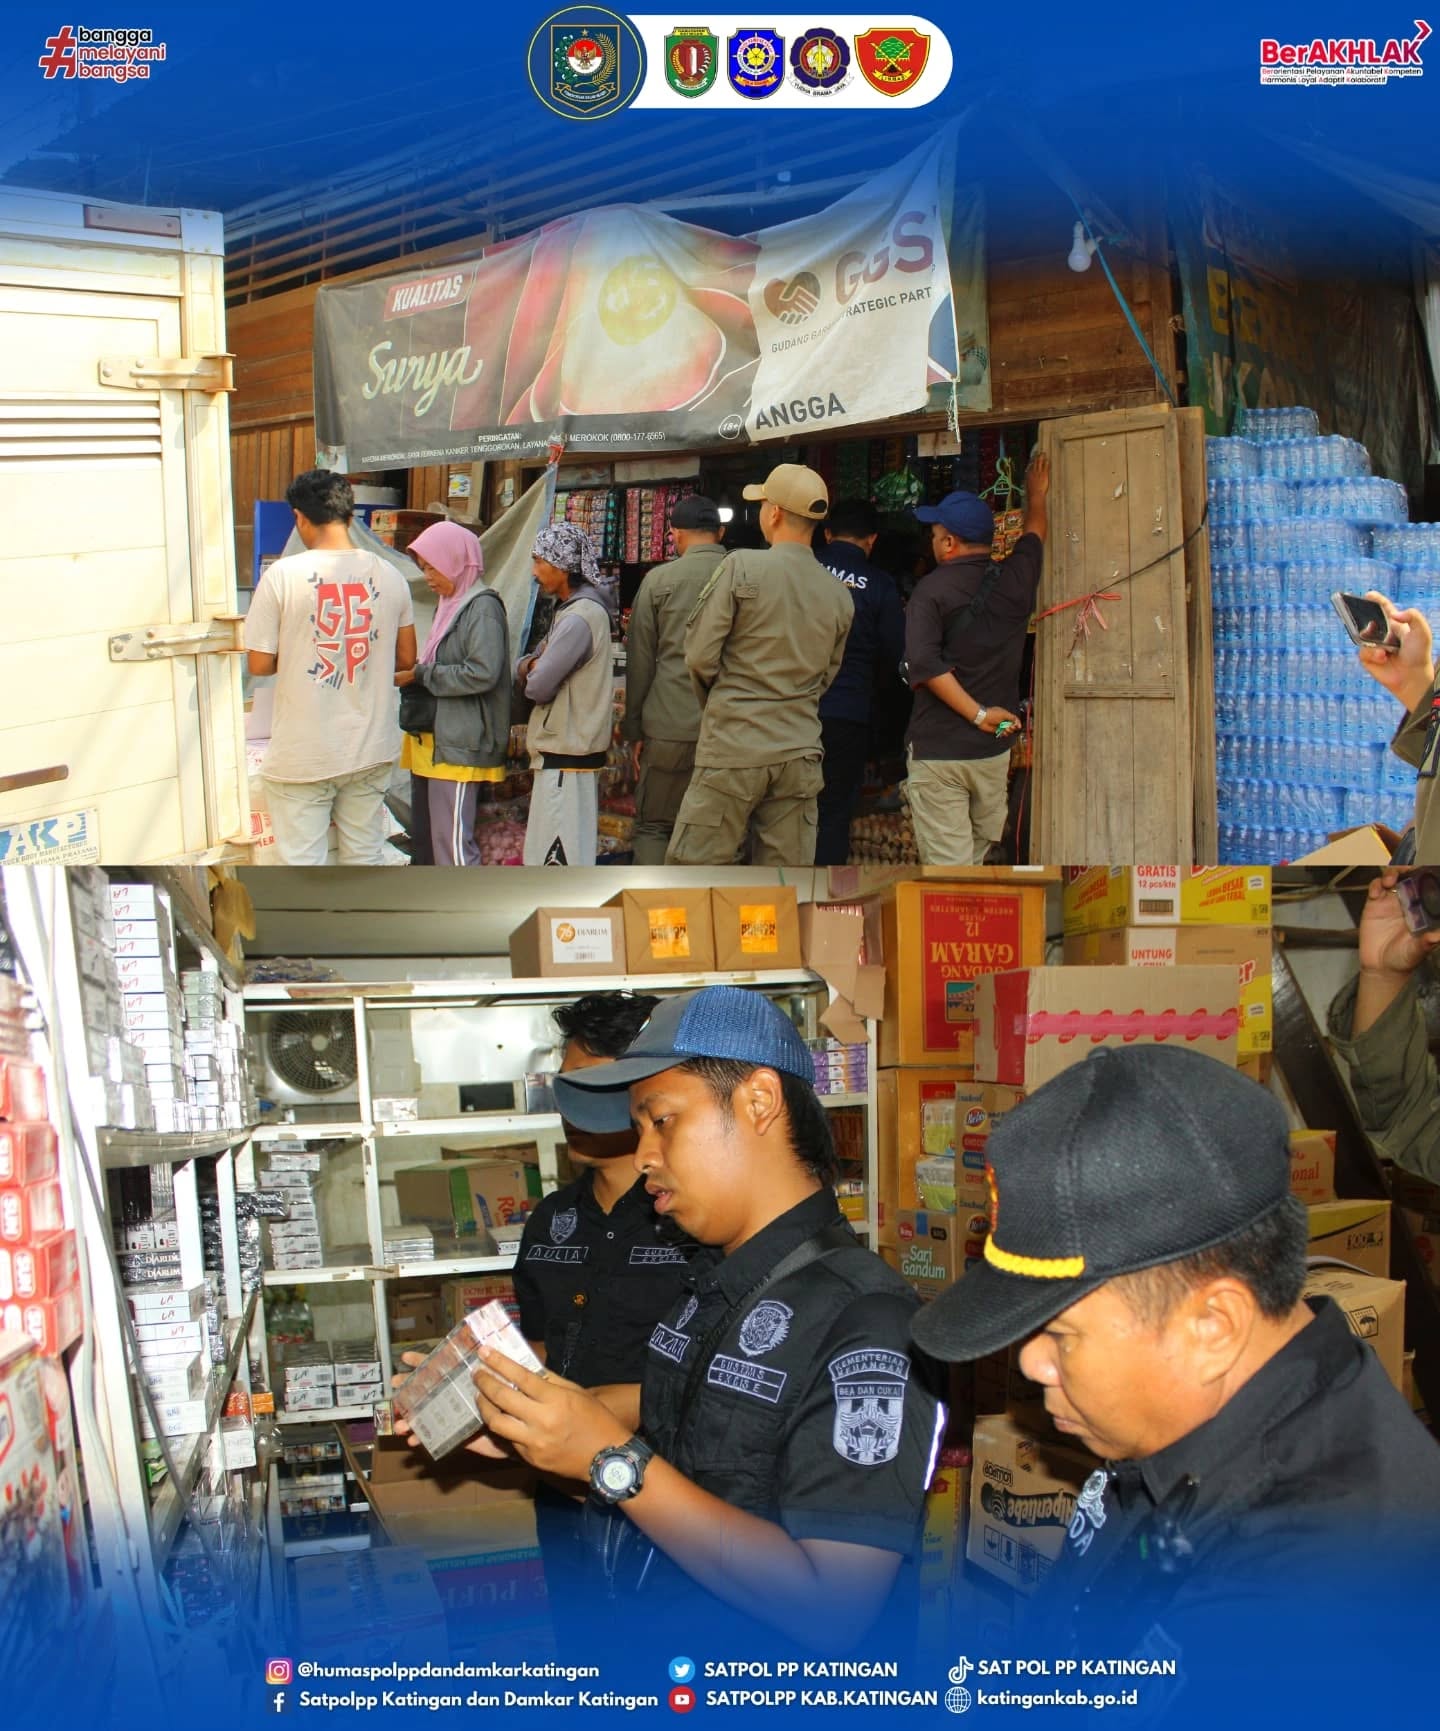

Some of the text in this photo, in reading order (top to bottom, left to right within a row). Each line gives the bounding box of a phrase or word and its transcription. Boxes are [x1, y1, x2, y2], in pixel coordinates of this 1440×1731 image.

[391, 273, 463, 313] KUALITAS
[771, 333, 809, 353] GUDANG
[362, 341, 484, 417] Surya
[755, 391, 847, 431] ANGGA
[569, 433, 609, 443] MEROKOK
[1137, 865, 1177, 877] GRATIS
[1137, 880, 1147, 889] 12
[965, 921, 979, 937] 12
[930, 942, 1014, 964] GARAM
[1131, 948, 1173, 961] UNTUNG
[534, 1247, 580, 1261] AULIA
[910, 1244, 933, 1265] Sari
[902, 1259, 946, 1280] Gandum
[834, 1353, 905, 1371] KEMENTERIAN
[857, 1387, 875, 1395] DAN
